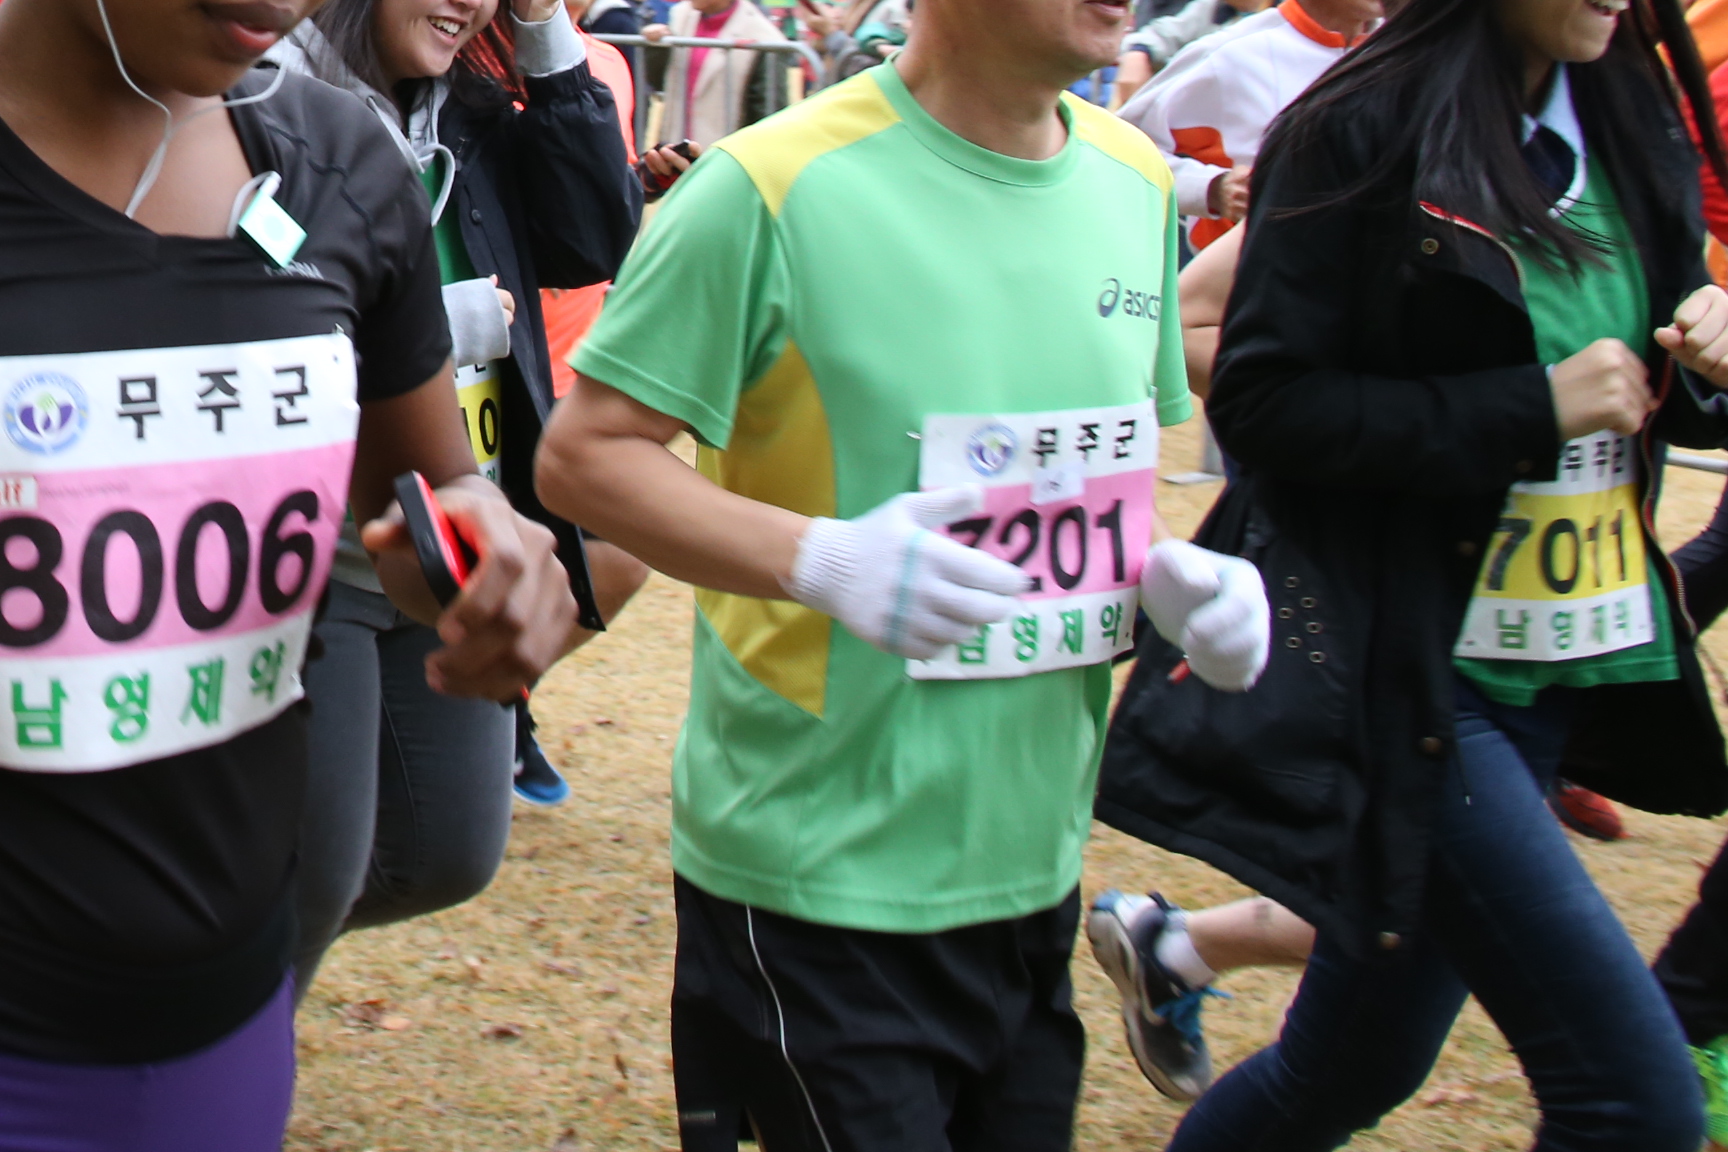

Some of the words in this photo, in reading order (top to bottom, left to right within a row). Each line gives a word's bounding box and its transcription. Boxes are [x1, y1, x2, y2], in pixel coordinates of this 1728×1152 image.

[116, 364, 310, 440] 무주군
[1030, 419, 1137, 468] 무주군
[1485, 508, 1629, 595] 7011
[10, 640, 287, 750] 남영제약
